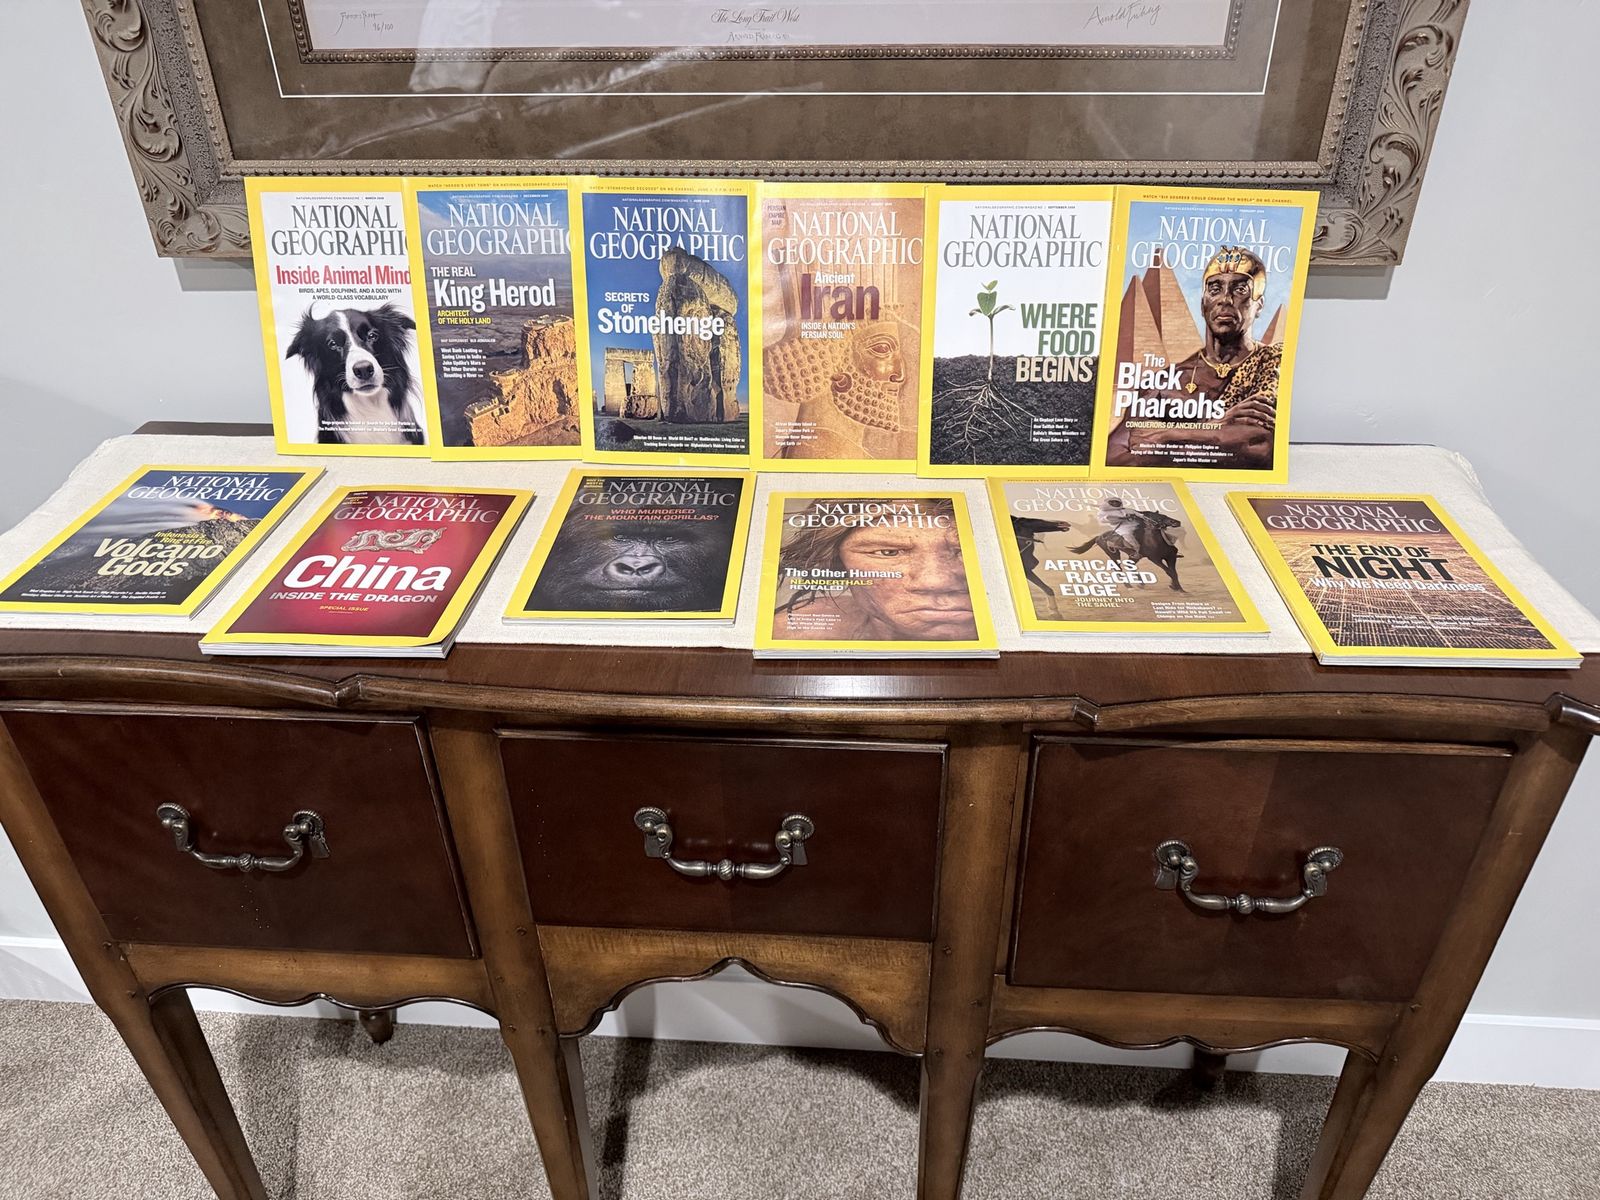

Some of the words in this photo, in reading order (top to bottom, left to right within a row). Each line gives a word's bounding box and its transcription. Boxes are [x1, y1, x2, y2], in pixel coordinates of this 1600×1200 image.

[291, 204, 398, 229] NATIONAL
[448, 202, 559, 228] NATIONAL
[612, 206, 724, 233] NATIONAL
[792, 211, 903, 237] NATIONAL
[970, 214, 1082, 239] NATIONAL
[1159, 215, 1272, 244] NATIONAL
[272, 229, 408, 256] GEOGRAPHI
[427, 228, 571, 256] GEOGRAPHI
[767, 237, 924, 265] GEOGRAPHIC
[943, 240, 1103, 268] GEOGRAPHIC
[1131, 241, 1291, 274] GEOGRIC
[276, 265, 320, 285] Inside
[323, 265, 372, 285] Animal
[431, 266, 450, 277] THE
[452, 266, 476, 277] REAL
[814, 271, 856, 284] Ancient
[434, 279, 486, 313] King
[489, 278, 556, 307] Herod
[605, 292, 650, 303] SECRETS
[801, 273, 880, 321] Iran
[621, 304, 635, 314] OF
[1021, 303, 1098, 329] WHERE
[598, 307, 725, 341] Stonehenge
[801, 322, 822, 330] INSIDE
[827, 322, 856, 330] NATION'S
[801, 331, 827, 339] PERSIAN
[828, 331, 844, 339] SOUL
[1038, 330, 1095, 356] FOOD
[1143, 353, 1166, 368] The
[1016, 357, 1094, 382] BEGINS
[1117, 362, 1184, 391] Black
[1114, 390, 1226, 420] Pharaohs
[1125, 421, 1166, 429] CONQUERORS
[163, 475, 270, 489] NATIONAL
[607, 481, 715, 494] NATIONAL
[127, 486, 285, 501] GEOGRAPHIC
[578, 492, 735, 506] GEOGRAPHIC
[1035, 488, 1150, 499] NATIONAL
[368, 495, 482, 510] NATIONAL
[815, 503, 927, 515] NATIONAL
[1013, 499, 1179, 513] GEOGRPHIC
[333, 507, 500, 523] GEOGRAPHIC
[1285, 504, 1407, 519] NATIONAL
[788, 514, 951, 529] GEOGRAPHIC
[1267, 515, 1441, 533] GEOGRAPHIC
[93, 538, 224, 559] Volcano
[1310, 544, 1356, 556] THE
[1358, 544, 1402, 557] END
[1404, 547, 1431, 557] OF
[97, 557, 189, 577] Gods
[283, 554, 452, 591] China
[784, 567, 808, 577] The
[811, 568, 847, 578] Other
[850, 569, 903, 579] Humans
[1044, 559, 1138, 571] AFRICA'S
[1312, 555, 1454, 581] NIGHT
[1065, 571, 1158, 584] RAGGED
[1311, 578, 1345, 589] Why
[1349, 578, 1371, 588] We
[1373, 579, 1412, 590] Need
[1414, 580, 1487, 592] Darkness
[269, 591, 323, 600] INSIDE
[329, 592, 361, 601] THE
[364, 593, 438, 603] DRAGON
[1059, 584, 1120, 597] EDGE
